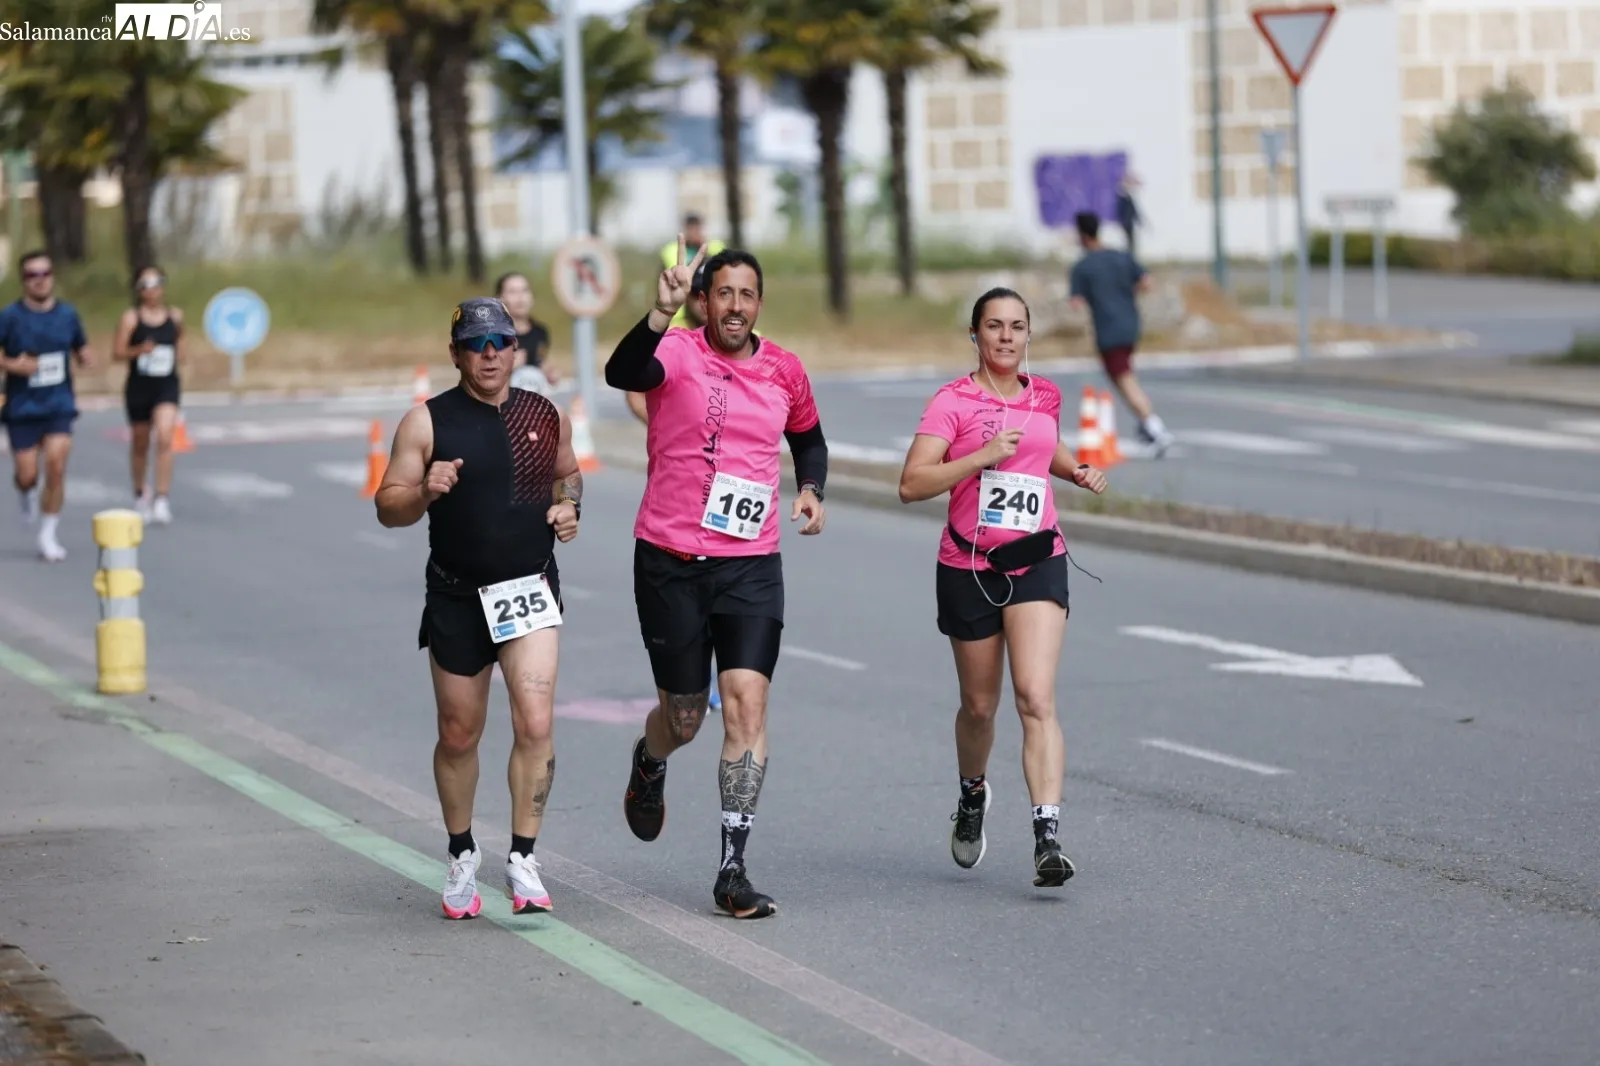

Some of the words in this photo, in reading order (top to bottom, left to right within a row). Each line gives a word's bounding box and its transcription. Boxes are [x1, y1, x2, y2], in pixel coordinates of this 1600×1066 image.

[705, 386, 723, 428] 2024
[701, 473, 713, 506] MEDIA
[987, 487, 1039, 516] 240
[719, 492, 765, 524] 162
[493, 591, 548, 624] 235
